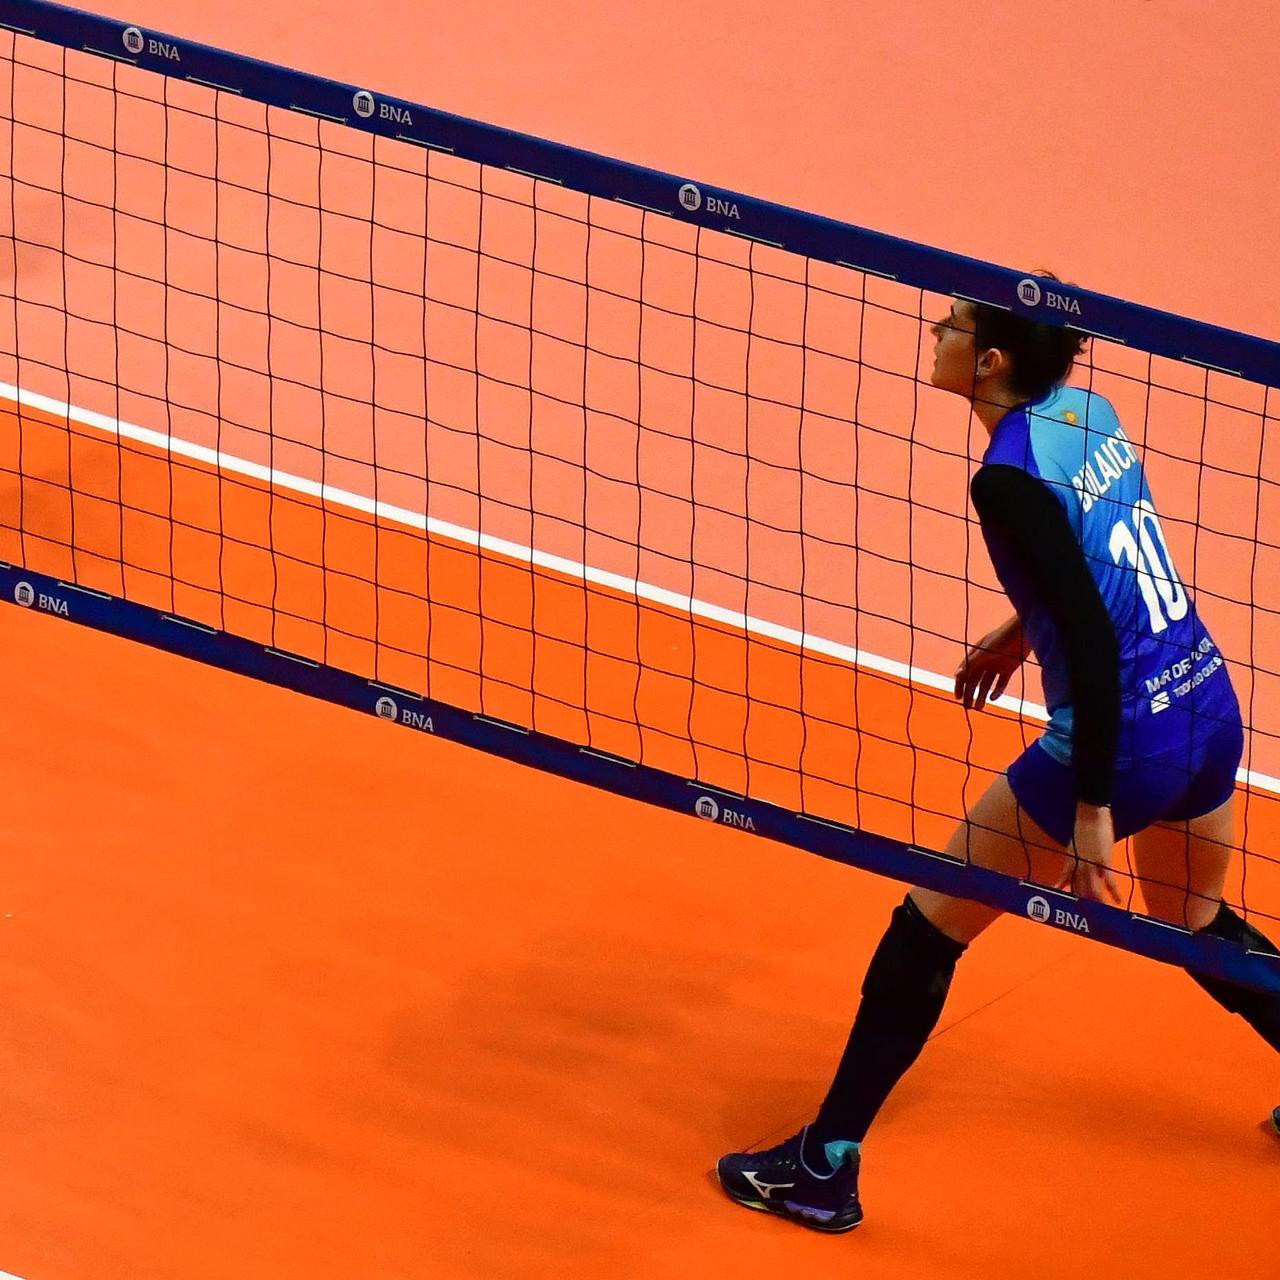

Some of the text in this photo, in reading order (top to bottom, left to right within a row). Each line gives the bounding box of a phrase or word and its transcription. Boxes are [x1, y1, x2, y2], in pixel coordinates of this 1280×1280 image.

[149, 40, 180, 61] BNA
[380, 104, 412, 125] BNA
[707, 197, 740, 219] BNA
[1046, 292, 1081, 314] BNA
[1108, 499, 1189, 634] 10
[39, 594, 69, 615] BNA
[402, 710, 433, 732] BNA
[723, 809, 755, 830] BNA
[1055, 910, 1089, 932] BNA
